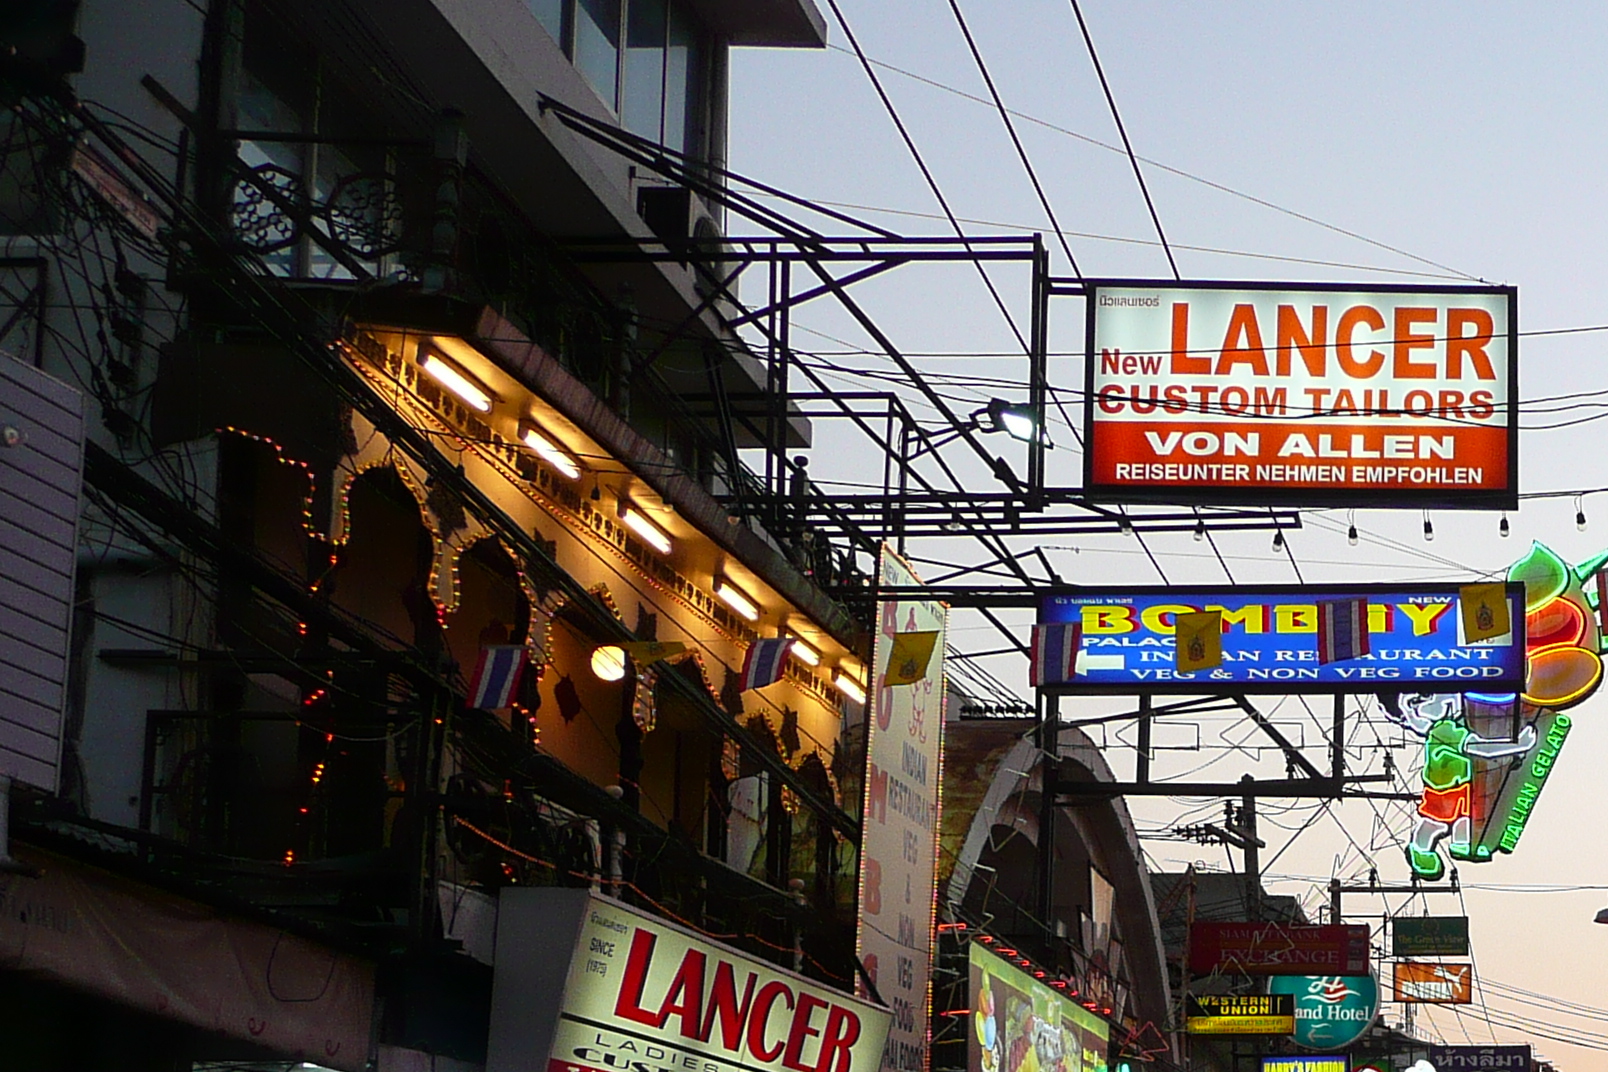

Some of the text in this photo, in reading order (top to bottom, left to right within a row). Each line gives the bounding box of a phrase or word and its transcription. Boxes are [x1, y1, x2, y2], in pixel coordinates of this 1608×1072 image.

[1101, 301, 1497, 380] New LANCER
[1098, 384, 1496, 420] CUSTOM TAILORS
[1144, 431, 1456, 460] VON ALLEN
[1115, 463, 1483, 484] REISEUNTER NEHMEN EMPFOHLEN
[1408, 596, 1453, 605] NEW
[1139, 650, 1262, 662] INAN
[1130, 665, 1505, 679] VEG & NON VEG FOOD
[1531, 714, 1572, 778] GELATO
[1499, 782, 1539, 852] ITALIAN
[589, 937, 616, 958] SINCE
[1221, 949, 1340, 964] EXCHANGE
[1198, 996, 1270, 1015] WESTERN UNION
[1326, 1005, 1370, 1021] Hotel
